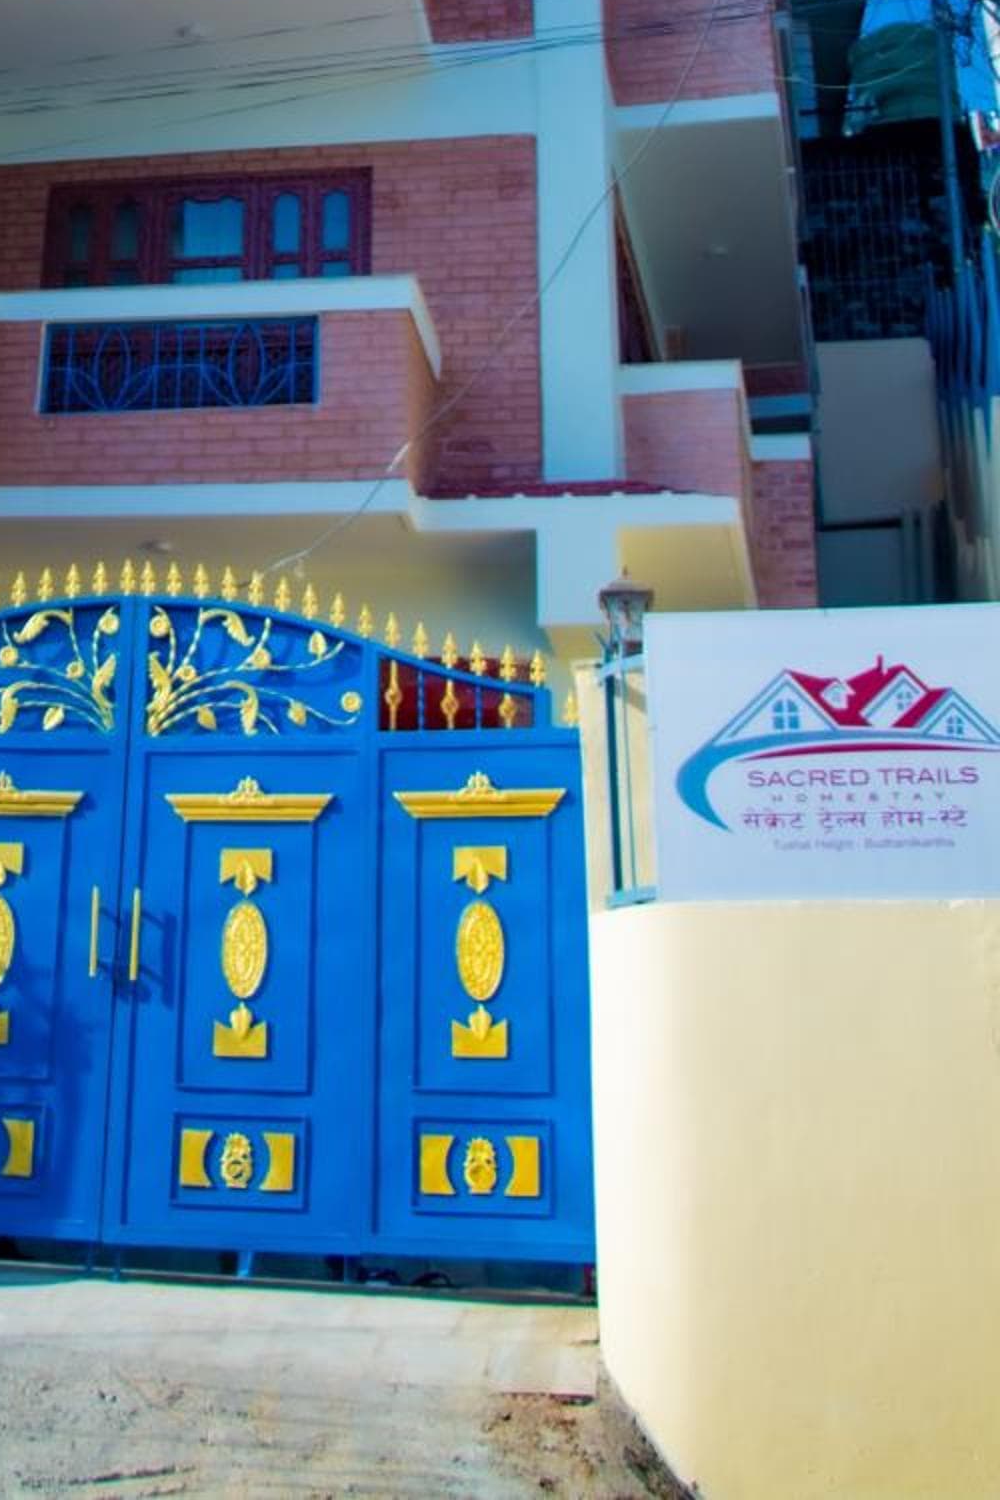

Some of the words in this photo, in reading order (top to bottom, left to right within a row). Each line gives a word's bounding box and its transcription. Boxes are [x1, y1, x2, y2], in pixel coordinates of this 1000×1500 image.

[747, 769, 869, 787] SACRED
[876, 765, 979, 785] TRAILS
[772, 791, 944, 802] HOMESTAY
